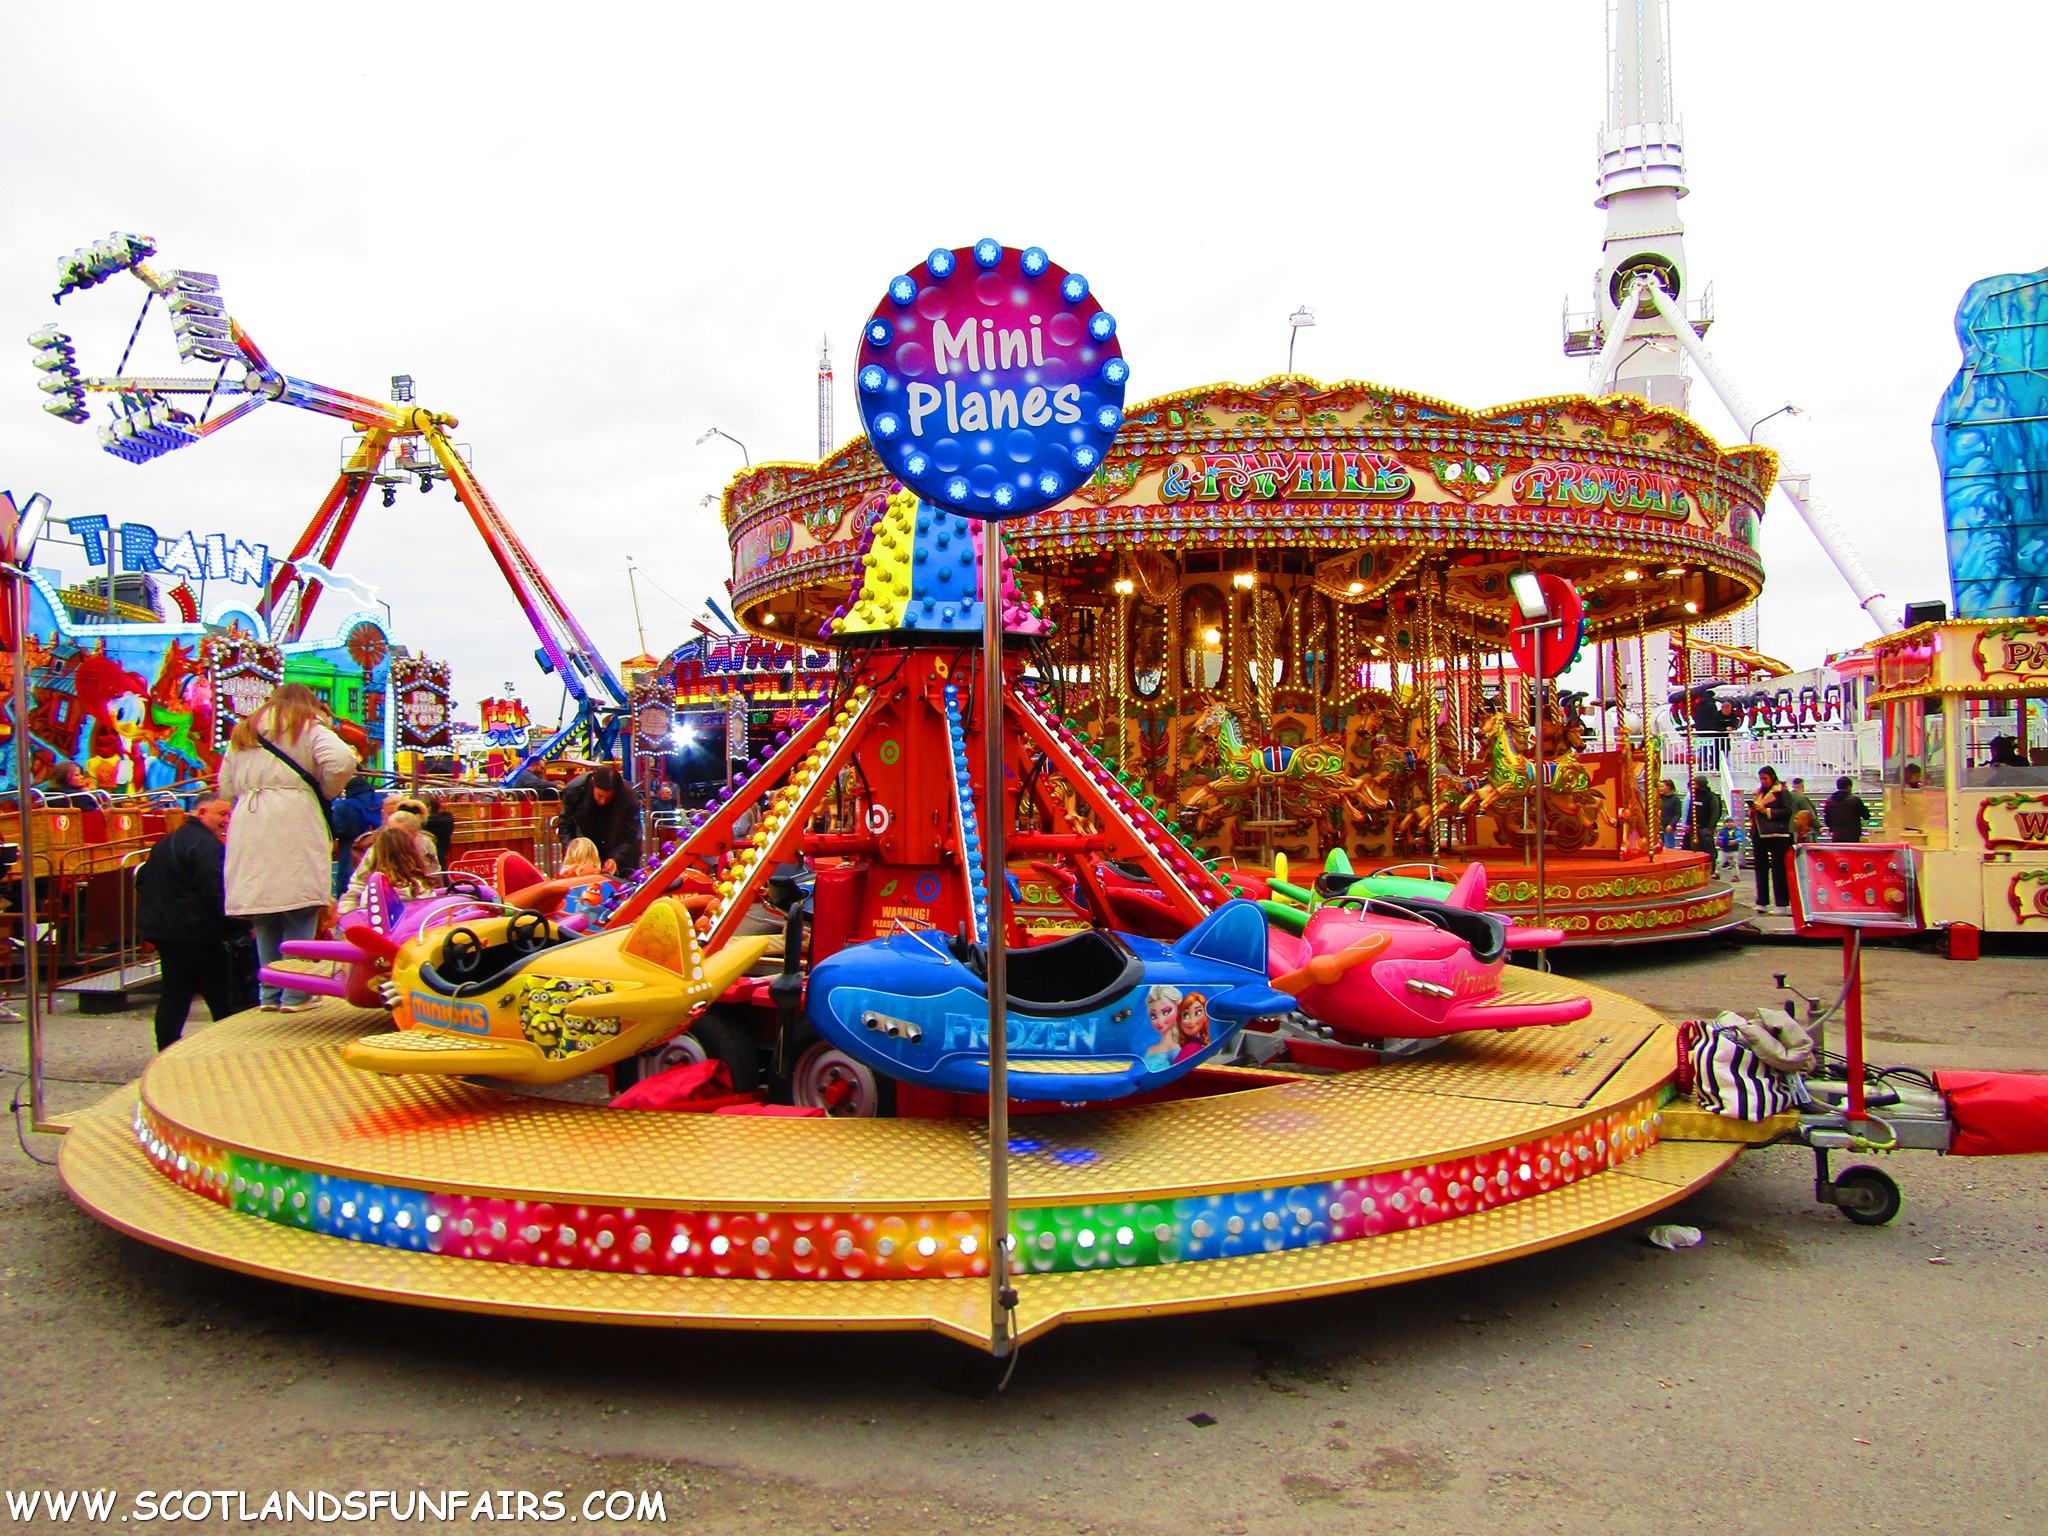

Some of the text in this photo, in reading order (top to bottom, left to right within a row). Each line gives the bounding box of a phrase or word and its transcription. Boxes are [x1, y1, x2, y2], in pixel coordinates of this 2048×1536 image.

[933, 315, 1044, 375] Mini
[906, 380, 1082, 436] Planes
[1160, 451, 1414, 503] & FAMILY
[1512, 462, 1691, 521] PROUDLY
[67, 514, 268, 588] TRAIN
[404, 703, 445, 714] YOUNG
[413, 691, 436, 703] FOR
[418, 713, 442, 726] OLD
[881, 905, 930, 920] WARNING!
[410, 997, 487, 1030] minions
[942, 1012, 1099, 1054] FROZEN
